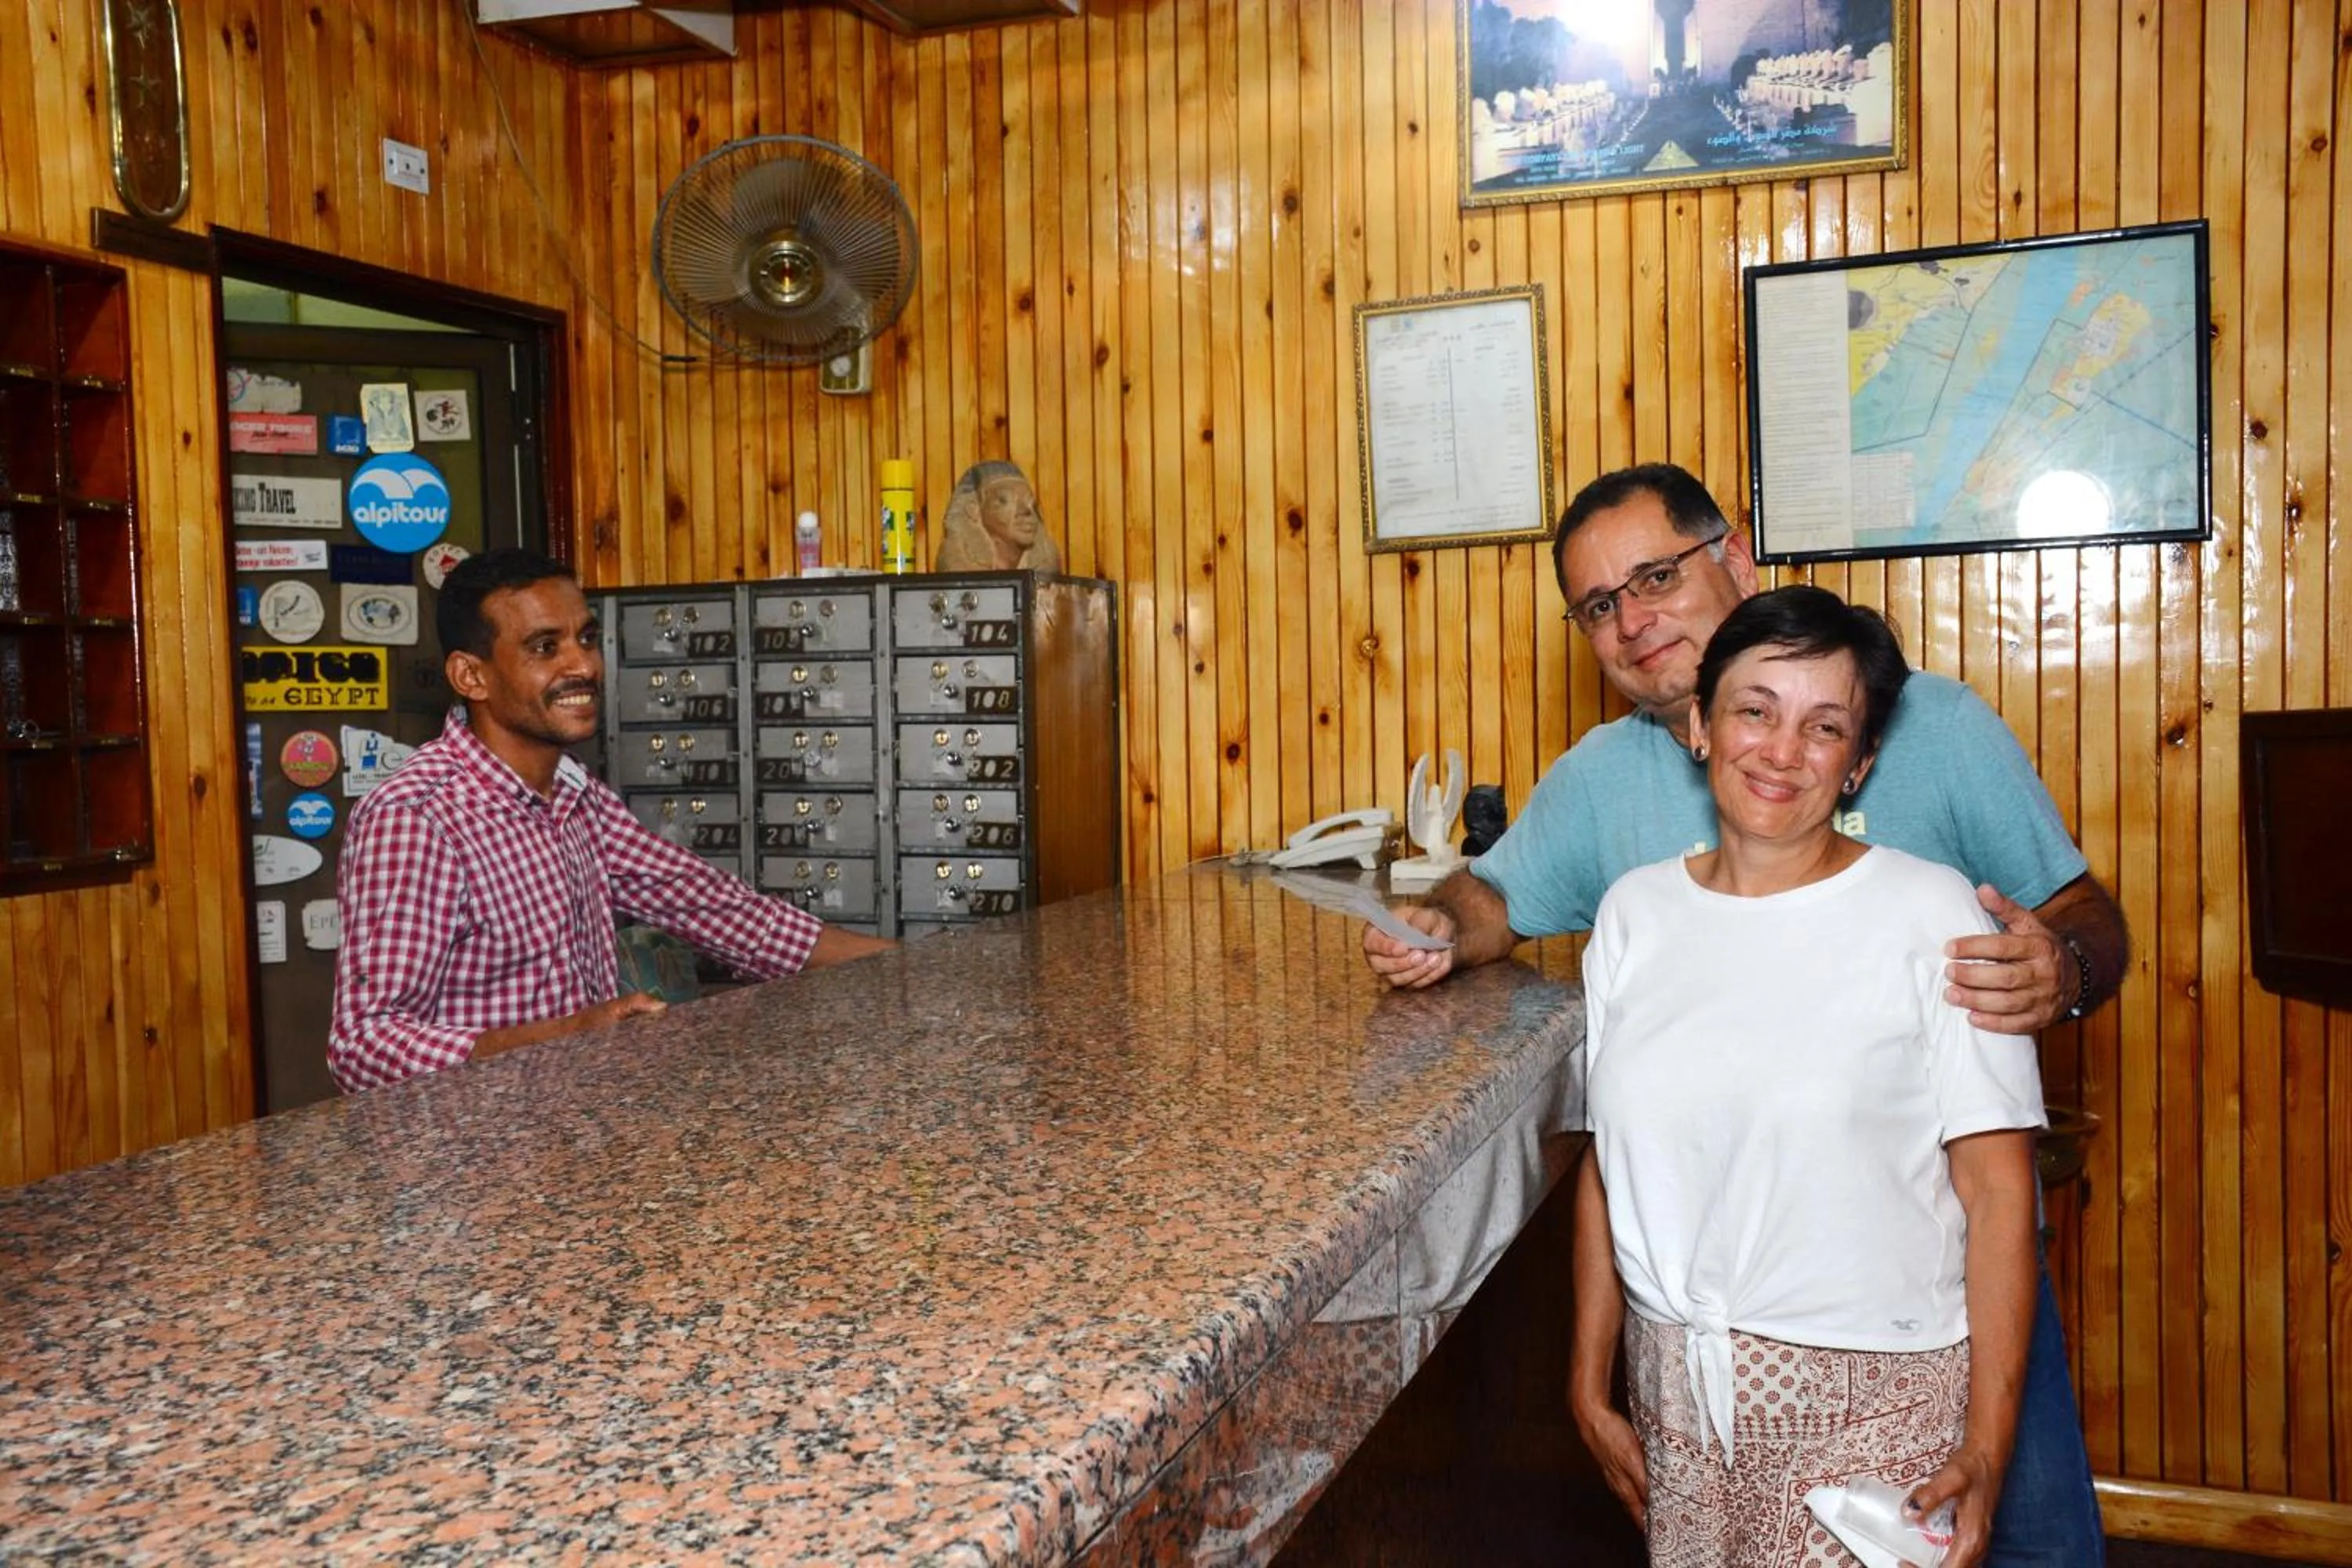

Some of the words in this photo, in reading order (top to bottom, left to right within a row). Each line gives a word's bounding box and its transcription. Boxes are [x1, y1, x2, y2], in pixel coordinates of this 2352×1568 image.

[257, 481, 297, 514] TRAVEL
[353, 501, 448, 528] alpitour
[694, 633, 732, 652] 102
[971, 622, 1009, 643] 104
[283, 686, 380, 706] EGYPT
[688, 699, 723, 717] 106
[763, 760, 803, 780] 20
[967, 758, 1014, 779] 202
[765, 826, 803, 846] 20
[971, 826, 1014, 845] 206
